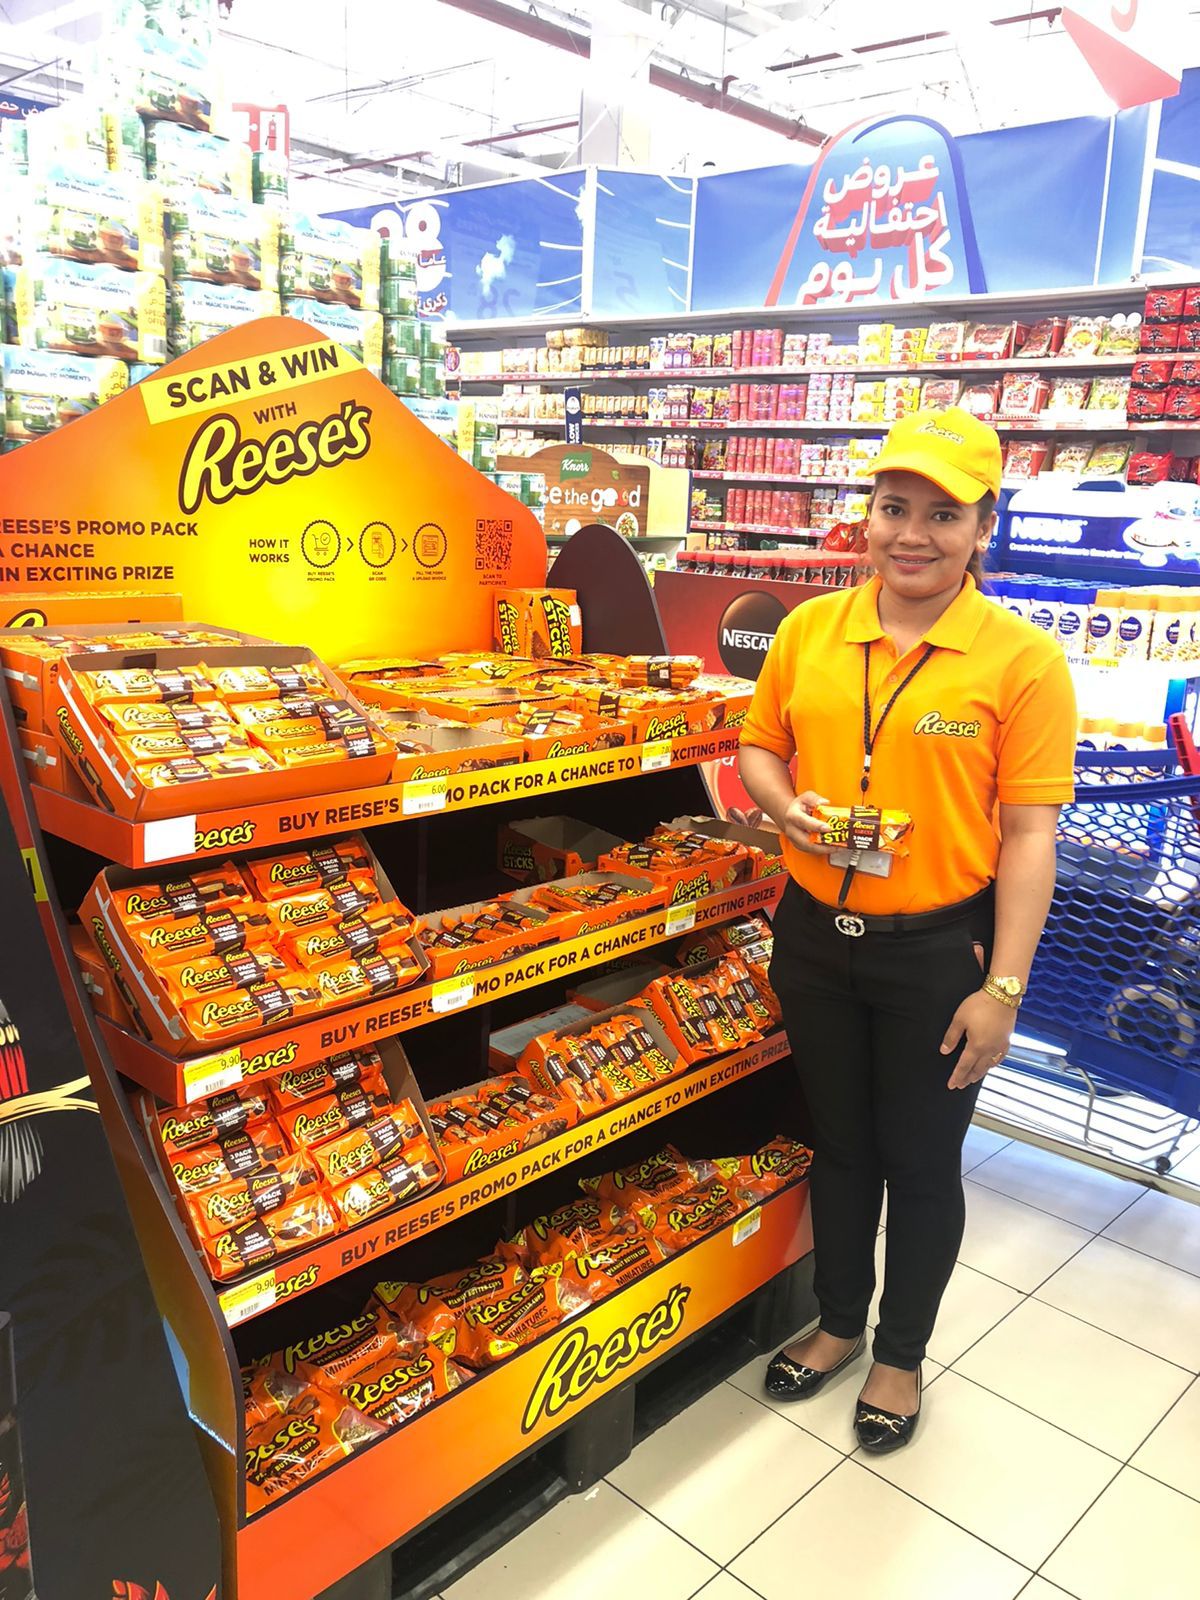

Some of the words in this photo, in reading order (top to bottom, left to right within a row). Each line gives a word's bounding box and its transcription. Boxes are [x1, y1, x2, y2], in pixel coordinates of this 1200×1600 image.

[822, 154, 941, 206] عروض
[812, 191, 949, 248] احتفالية
[896, 231, 954, 298] كل
[167, 366, 252, 409] SCAN
[258, 361, 277, 386] &
[281, 344, 340, 379] WIN
[253, 402, 298, 425] WITH
[178, 399, 373, 516] Reese's
[561, 460, 590, 472] Knorr
[564, 487, 589, 505] the
[0, 518, 71, 536] EESE'S
[77, 520, 145, 537] PROMO
[151, 521, 199, 537] PACK
[15, 543, 95, 559] CHANCE
[249, 538, 274, 549] HOW
[278, 538, 289, 549] IT
[249, 553, 290, 564] WORKS
[26, 566, 118, 582] EXCITING
[123, 565, 174, 581] PRIZE
[646, 709, 687, 740] Reese's
[913, 711, 981, 739] Reese's
[673, 741, 716, 763] XCITING
[718, 737, 740, 754] PRIZ
[469, 780, 510, 802] PACK
[514, 773, 544, 792] FOR
[547, 769, 558, 785] A
[560, 762, 615, 784] CHANCE
[617, 757, 635, 772] TO
[279, 810, 320, 833] BUY
[325, 799, 400, 824] REESE'S
[193, 820, 256, 850] eese's
[323, 858, 339, 866] PACK
[330, 881, 351, 891] Reese's
[342, 891, 358, 900] PACK
[672, 870, 709, 902] Reese's
[179, 893, 198, 902] PACK
[695, 897, 745, 923] EXCITING
[747, 886, 777, 908] PRIZE
[205, 913, 232, 926] Reese's
[279, 898, 330, 923] Reese's
[219, 923, 238, 933] PACK
[339, 919, 362, 930] Reese's
[351, 928, 369, 938] PACK
[149, 922, 209, 949] Reese's
[225, 951, 250, 963] Reese's
[361, 954, 383, 965] Reese's
[504, 963, 545, 988] PACK
[548, 951, 578, 973] FOR
[580, 946, 591, 961] A
[594, 932, 639, 957] CHANCE
[643, 923, 666, 941] TO
[238, 962, 257, 972] PACK
[373, 965, 390, 974] PACK
[250, 980, 276, 991] Reese's
[262, 991, 281, 1000] PACK
[321, 1025, 361, 1048] BUY
[365, 1001, 434, 1034] REESE'S
[221, 1054, 240, 1071] 9.90
[240, 1041, 298, 1077] eese's
[280, 1063, 330, 1094] Reese's
[340, 1089, 362, 1101] Reese's
[351, 1100, 367, 1110] PACK
[293, 1106, 343, 1138] Reese's
[378, 1123, 395, 1135] PACK
[223, 1135, 249, 1149] Reese's
[234, 1148, 253, 1159] PACK
[328, 1139, 376, 1176] Reese's
[341, 1242, 382, 1268] BUY
[385, 1201, 455, 1245] REESE'S
[459, 1172, 518, 1210] PROMO
[521, 1151, 561, 1180] PACK
[565, 1135, 593, 1160] FOR
[595, 1128, 606, 1145] A
[609, 1102, 662, 1136] CHANCE
[664, 1091, 681, 1109] TO
[684, 1079, 707, 1100] WIN
[709, 1054, 759, 1090] EXCITING
[761, 1039, 791, 1063] PRIZE
[463, 1137, 520, 1177] Reese's
[252, 1176, 279, 1191] Reese's
[616, 1258, 655, 1286] MINIATURES
[257, 1276, 275, 1294] 9.90
[465, 1274, 547, 1330] Reese's
[520, 1282, 692, 1435] Reese's
[342, 1353, 435, 1411] Reese's
[299, 1437, 319, 1456] CUPS
